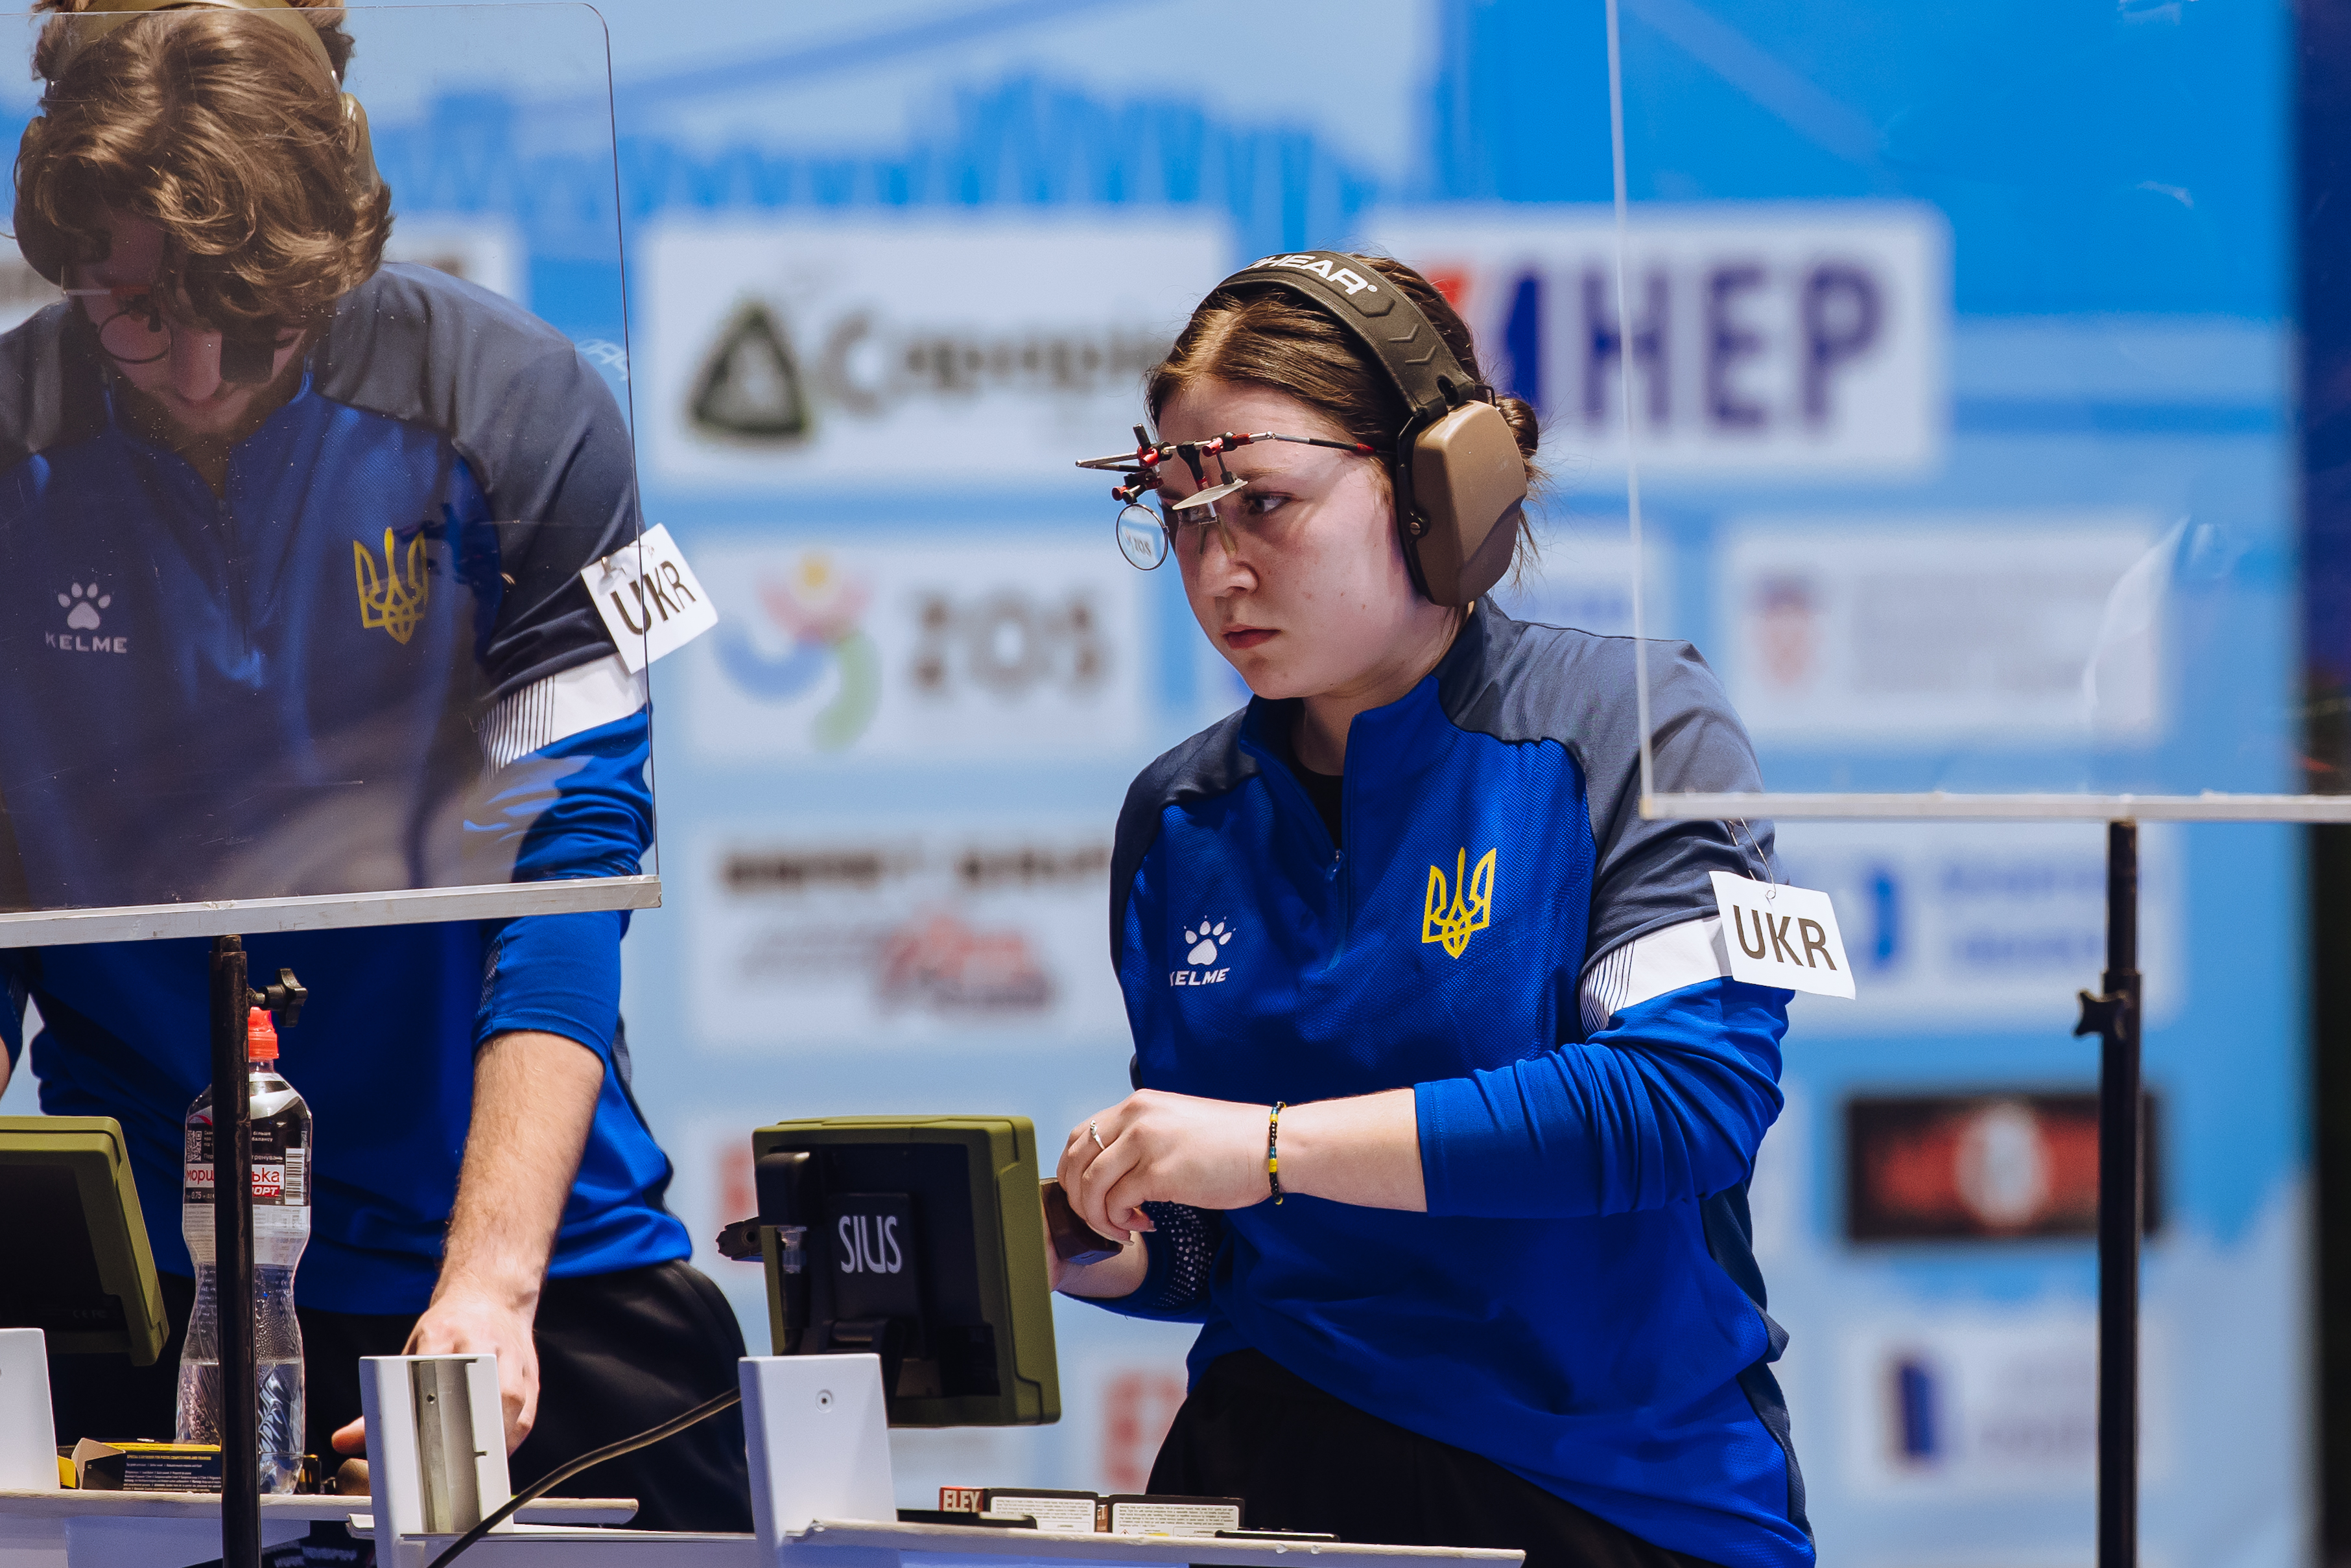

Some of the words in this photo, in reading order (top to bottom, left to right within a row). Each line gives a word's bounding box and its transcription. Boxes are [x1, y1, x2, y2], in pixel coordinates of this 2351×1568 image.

[1579, 264, 1884, 429] HEP
[610, 560, 696, 635] UKR
[45, 631, 128, 654] KELME
[1732, 904, 1837, 971] UKR
[838, 1215, 903, 1274] SIUS
[943, 1490, 980, 1512] ELEY
